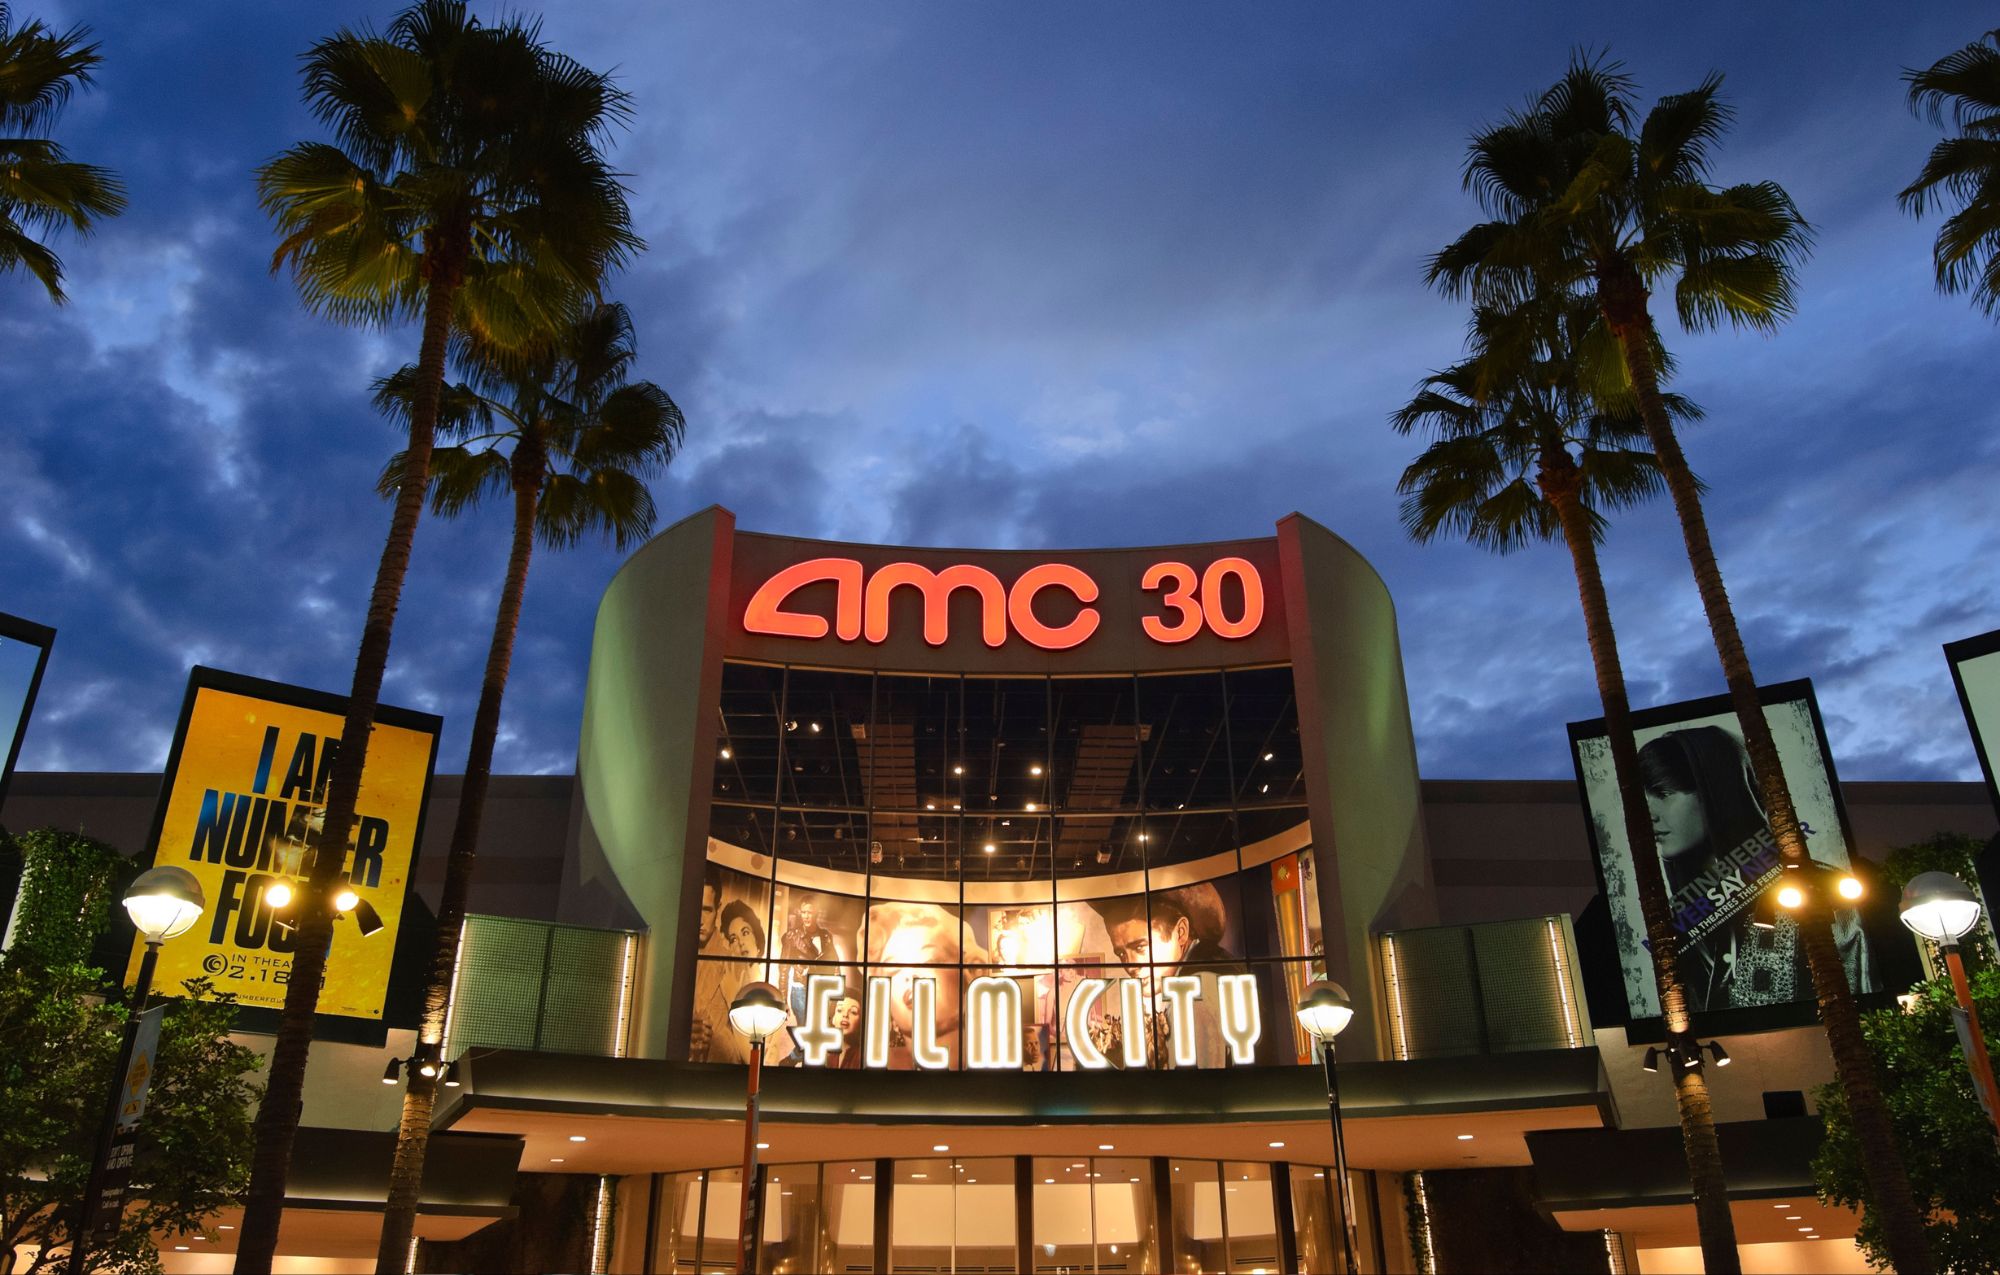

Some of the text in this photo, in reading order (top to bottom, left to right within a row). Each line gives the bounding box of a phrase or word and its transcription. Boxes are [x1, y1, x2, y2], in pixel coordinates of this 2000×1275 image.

[1141, 557, 1264, 643] 30
[252, 725, 280, 795] I
[1715, 827, 1777, 877] BIEBE
[1688, 864, 1783, 939] IN THEATRES THIS FEBRU
[1707, 868, 1747, 908] SAY
[231, 953, 247, 963] IN
[787, 973, 1262, 1070] FILM CITY
